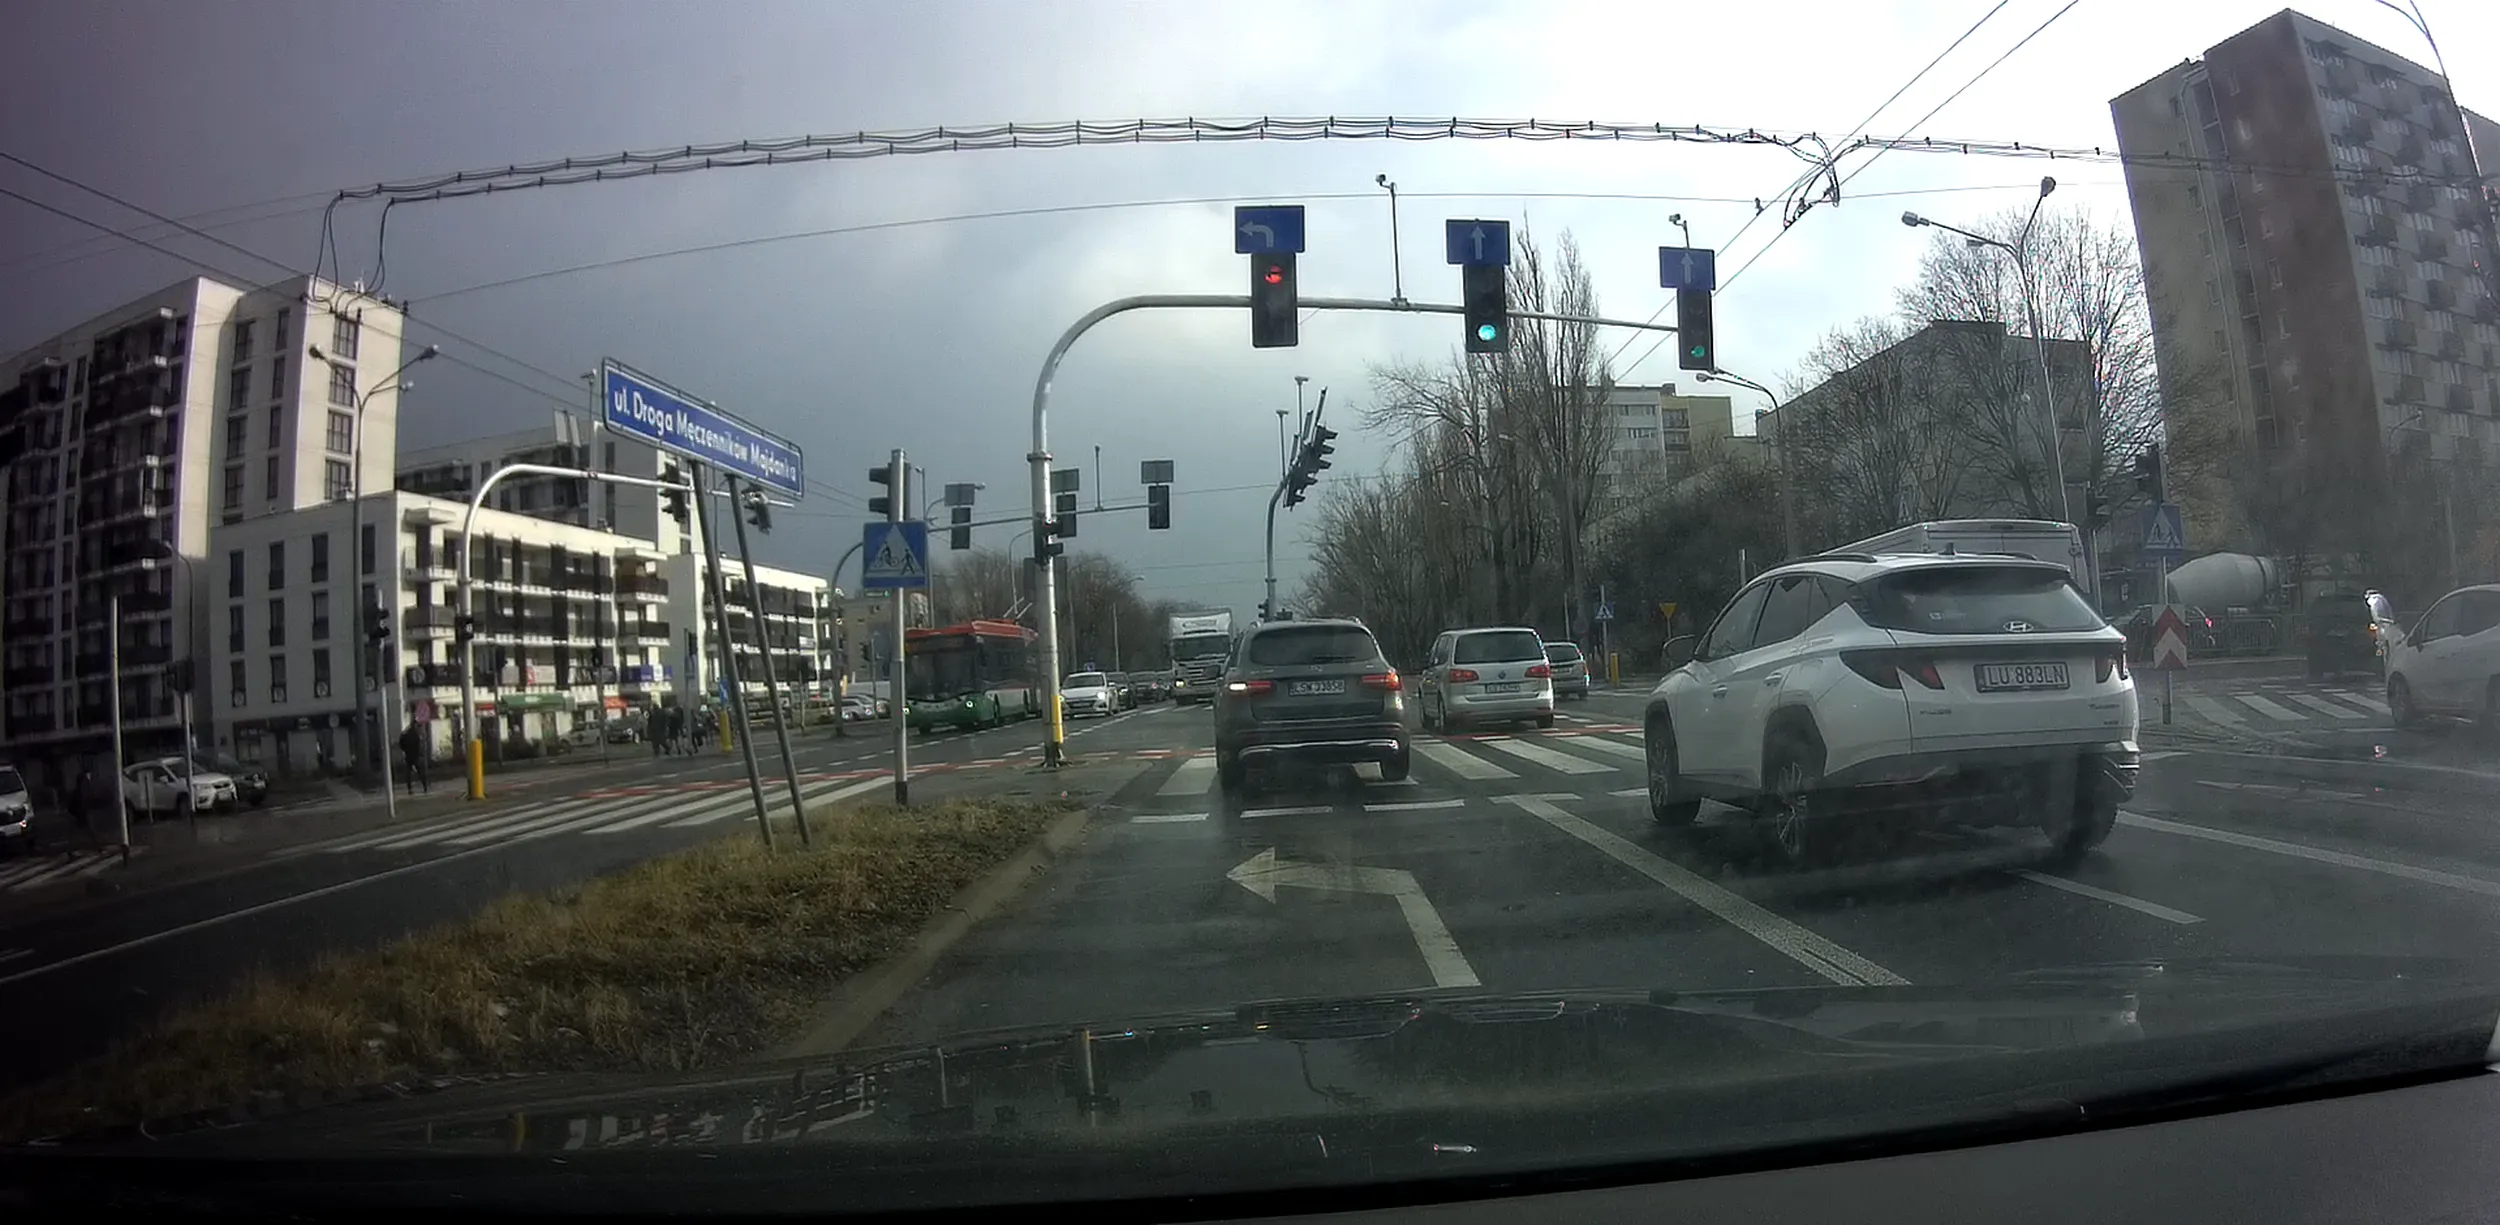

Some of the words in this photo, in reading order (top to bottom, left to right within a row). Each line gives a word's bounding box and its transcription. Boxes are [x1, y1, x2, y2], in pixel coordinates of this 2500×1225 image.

[614, 386, 630, 416] ul.
[633, 390, 673, 435] Droga
[676, 410, 748, 461] Męczenników
[1987, 665, 2010, 686] LU
[2015, 665, 2065, 684] 883LN
